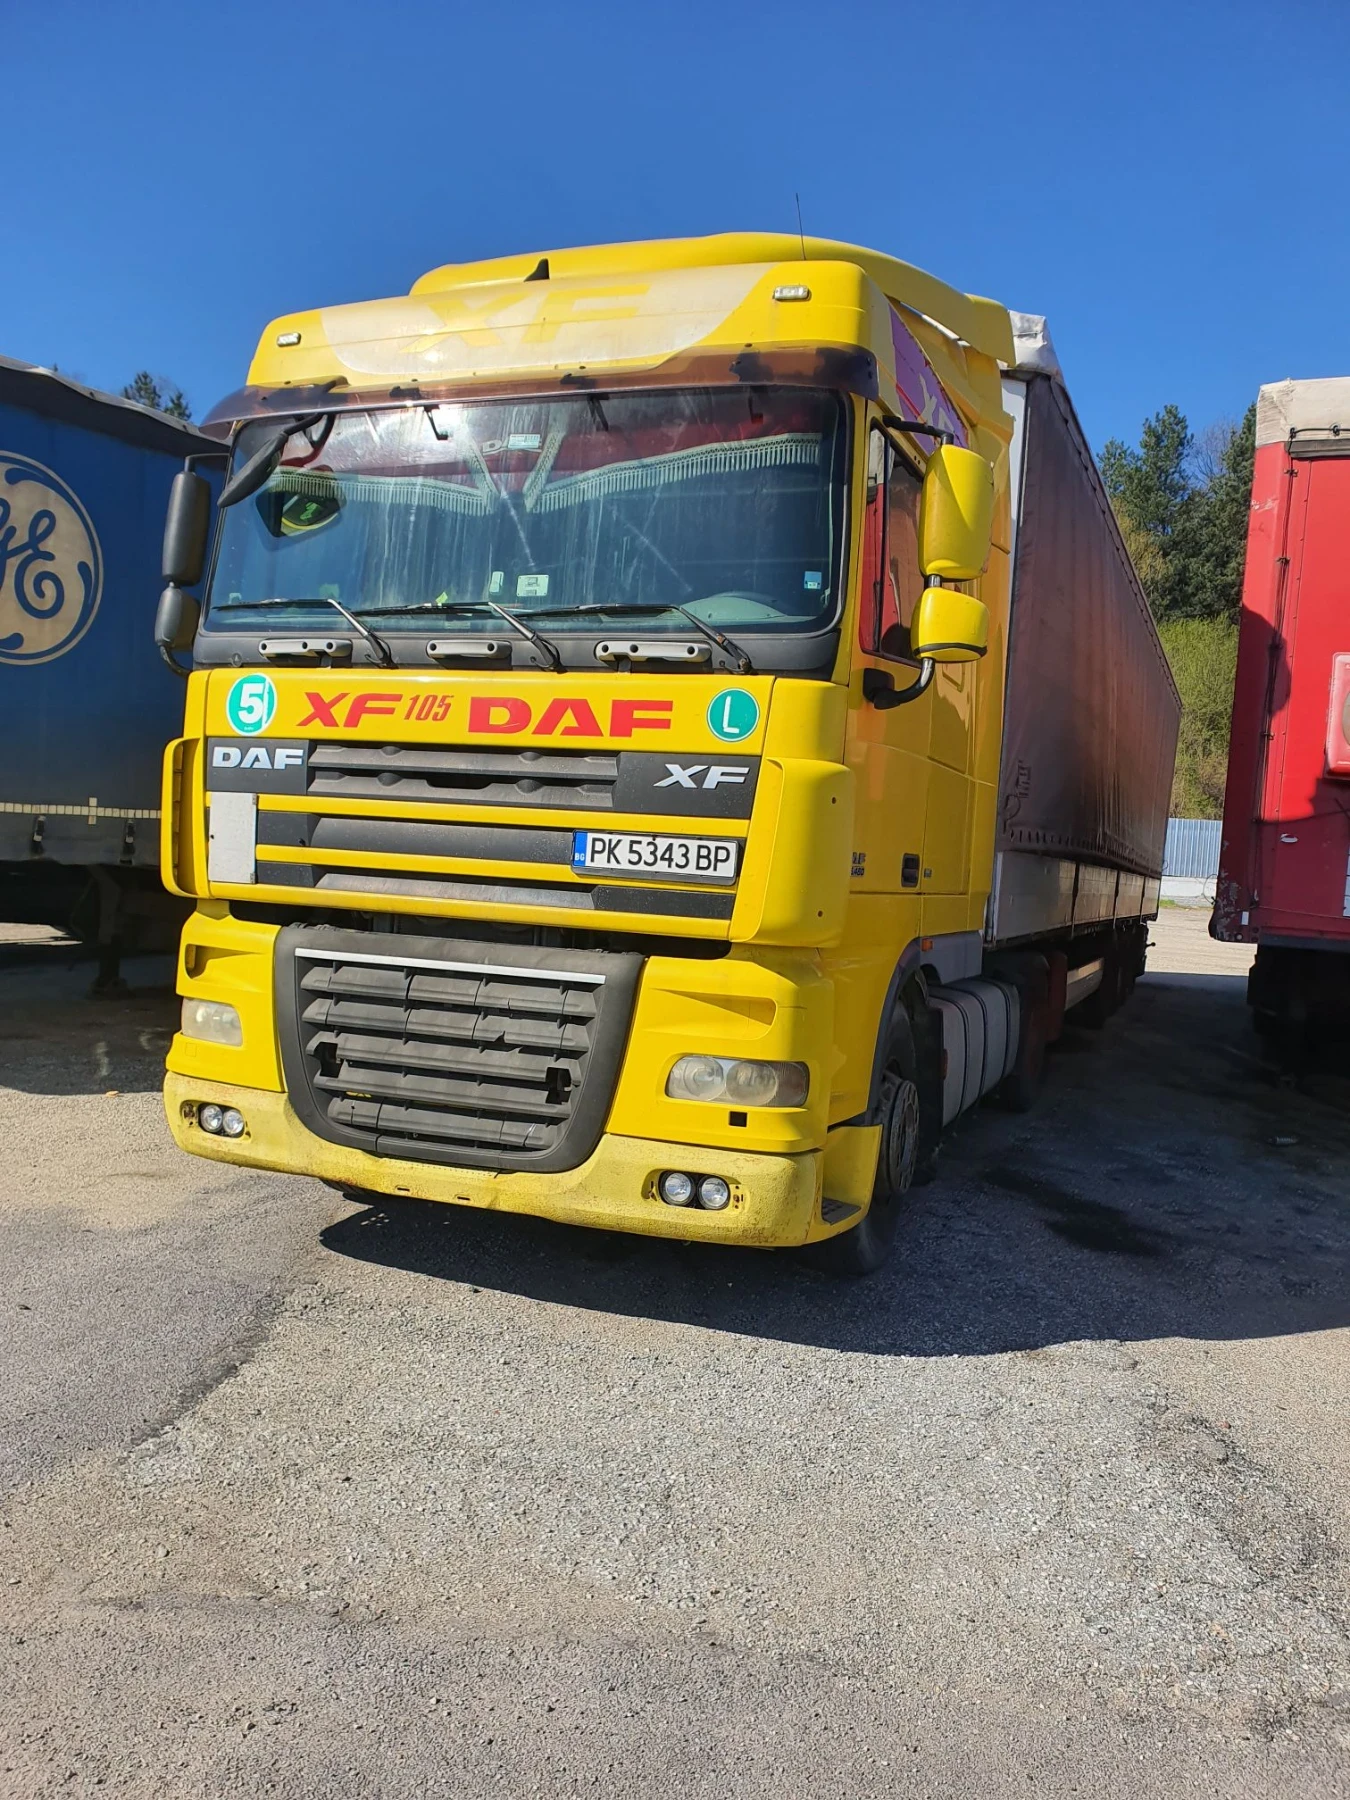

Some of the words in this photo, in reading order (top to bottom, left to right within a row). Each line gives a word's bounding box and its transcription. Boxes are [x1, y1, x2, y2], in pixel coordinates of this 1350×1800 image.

[399, 284, 650, 354] XF
[0, 497, 65, 619] E
[237, 683, 264, 724] 5
[296, 692, 404, 728] XF
[404, 694, 454, 722] 105
[468, 697, 673, 737] DAF
[722, 696, 740, 734] L
[212, 746, 304, 770] DAF
[653, 764, 750, 789] XF
[574, 852, 585, 861] BG
[590, 837, 623, 865] PK
[628, 839, 690, 869] 5343
[695, 844, 731, 872] BP
